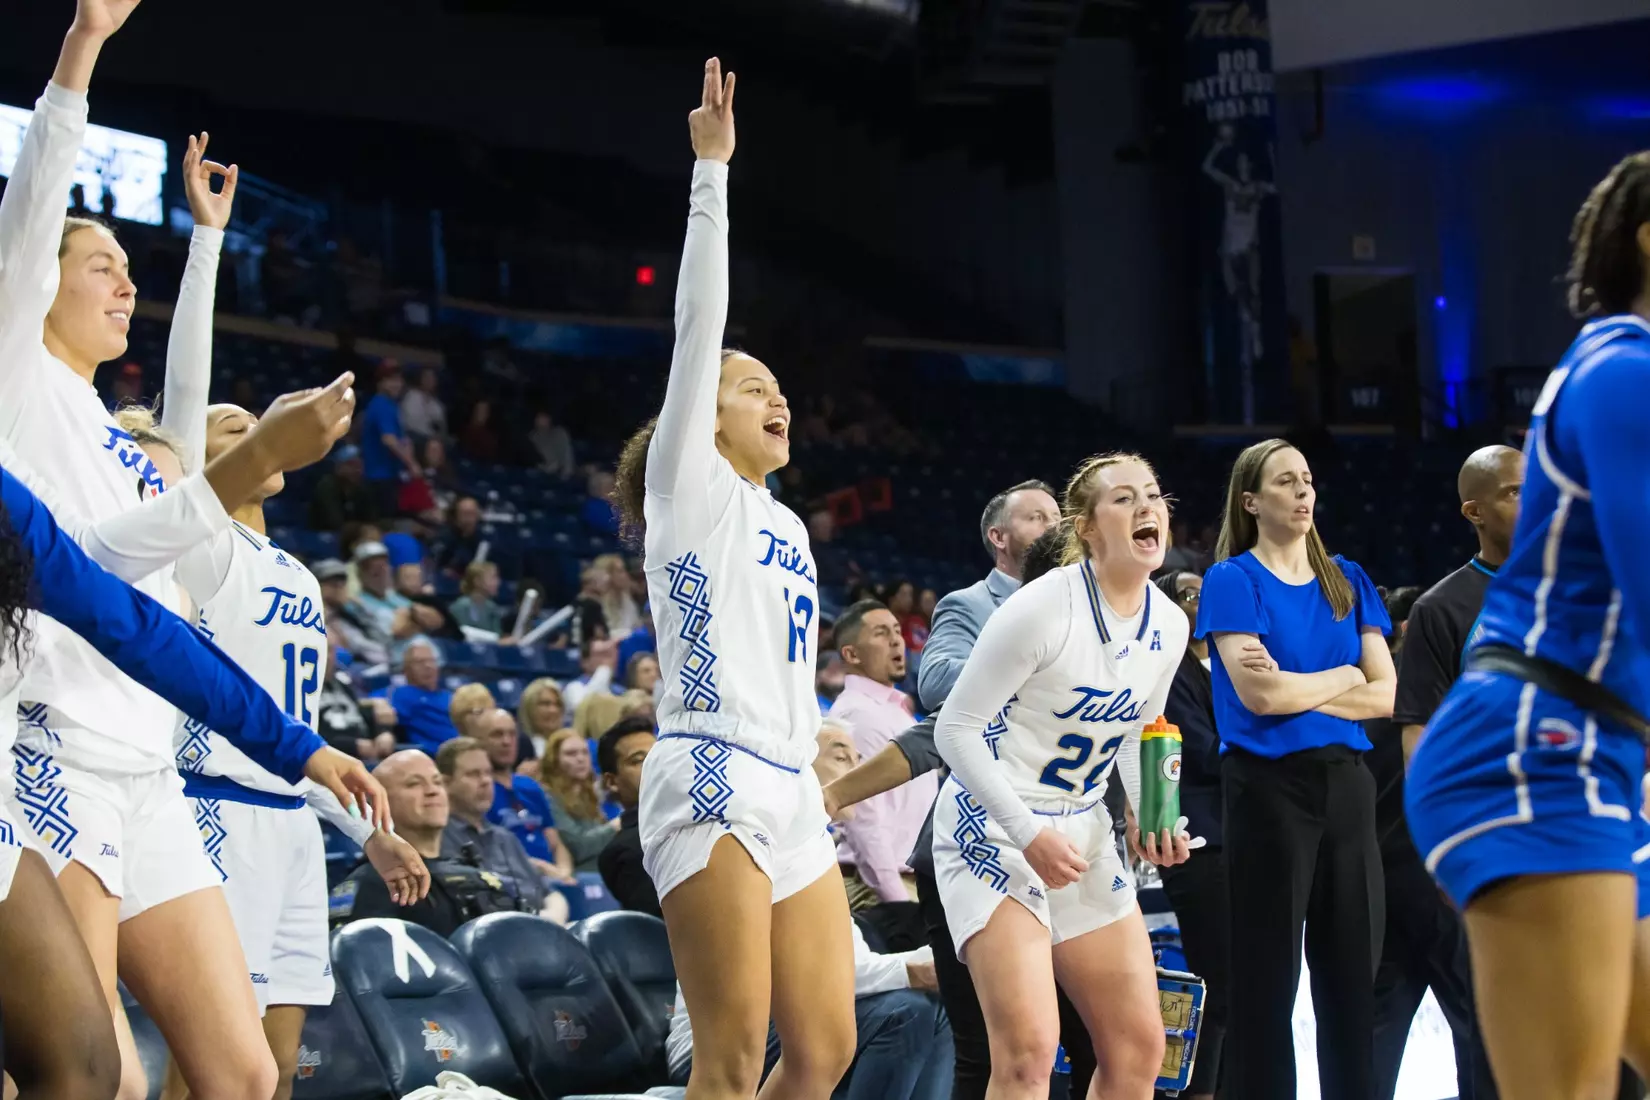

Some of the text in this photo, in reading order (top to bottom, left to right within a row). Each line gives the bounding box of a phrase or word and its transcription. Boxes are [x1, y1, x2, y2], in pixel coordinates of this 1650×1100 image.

[1181, 71, 1275, 106] PATTERSO
[757, 529, 816, 585] Tuls
[253, 586, 328, 638] Tuls
